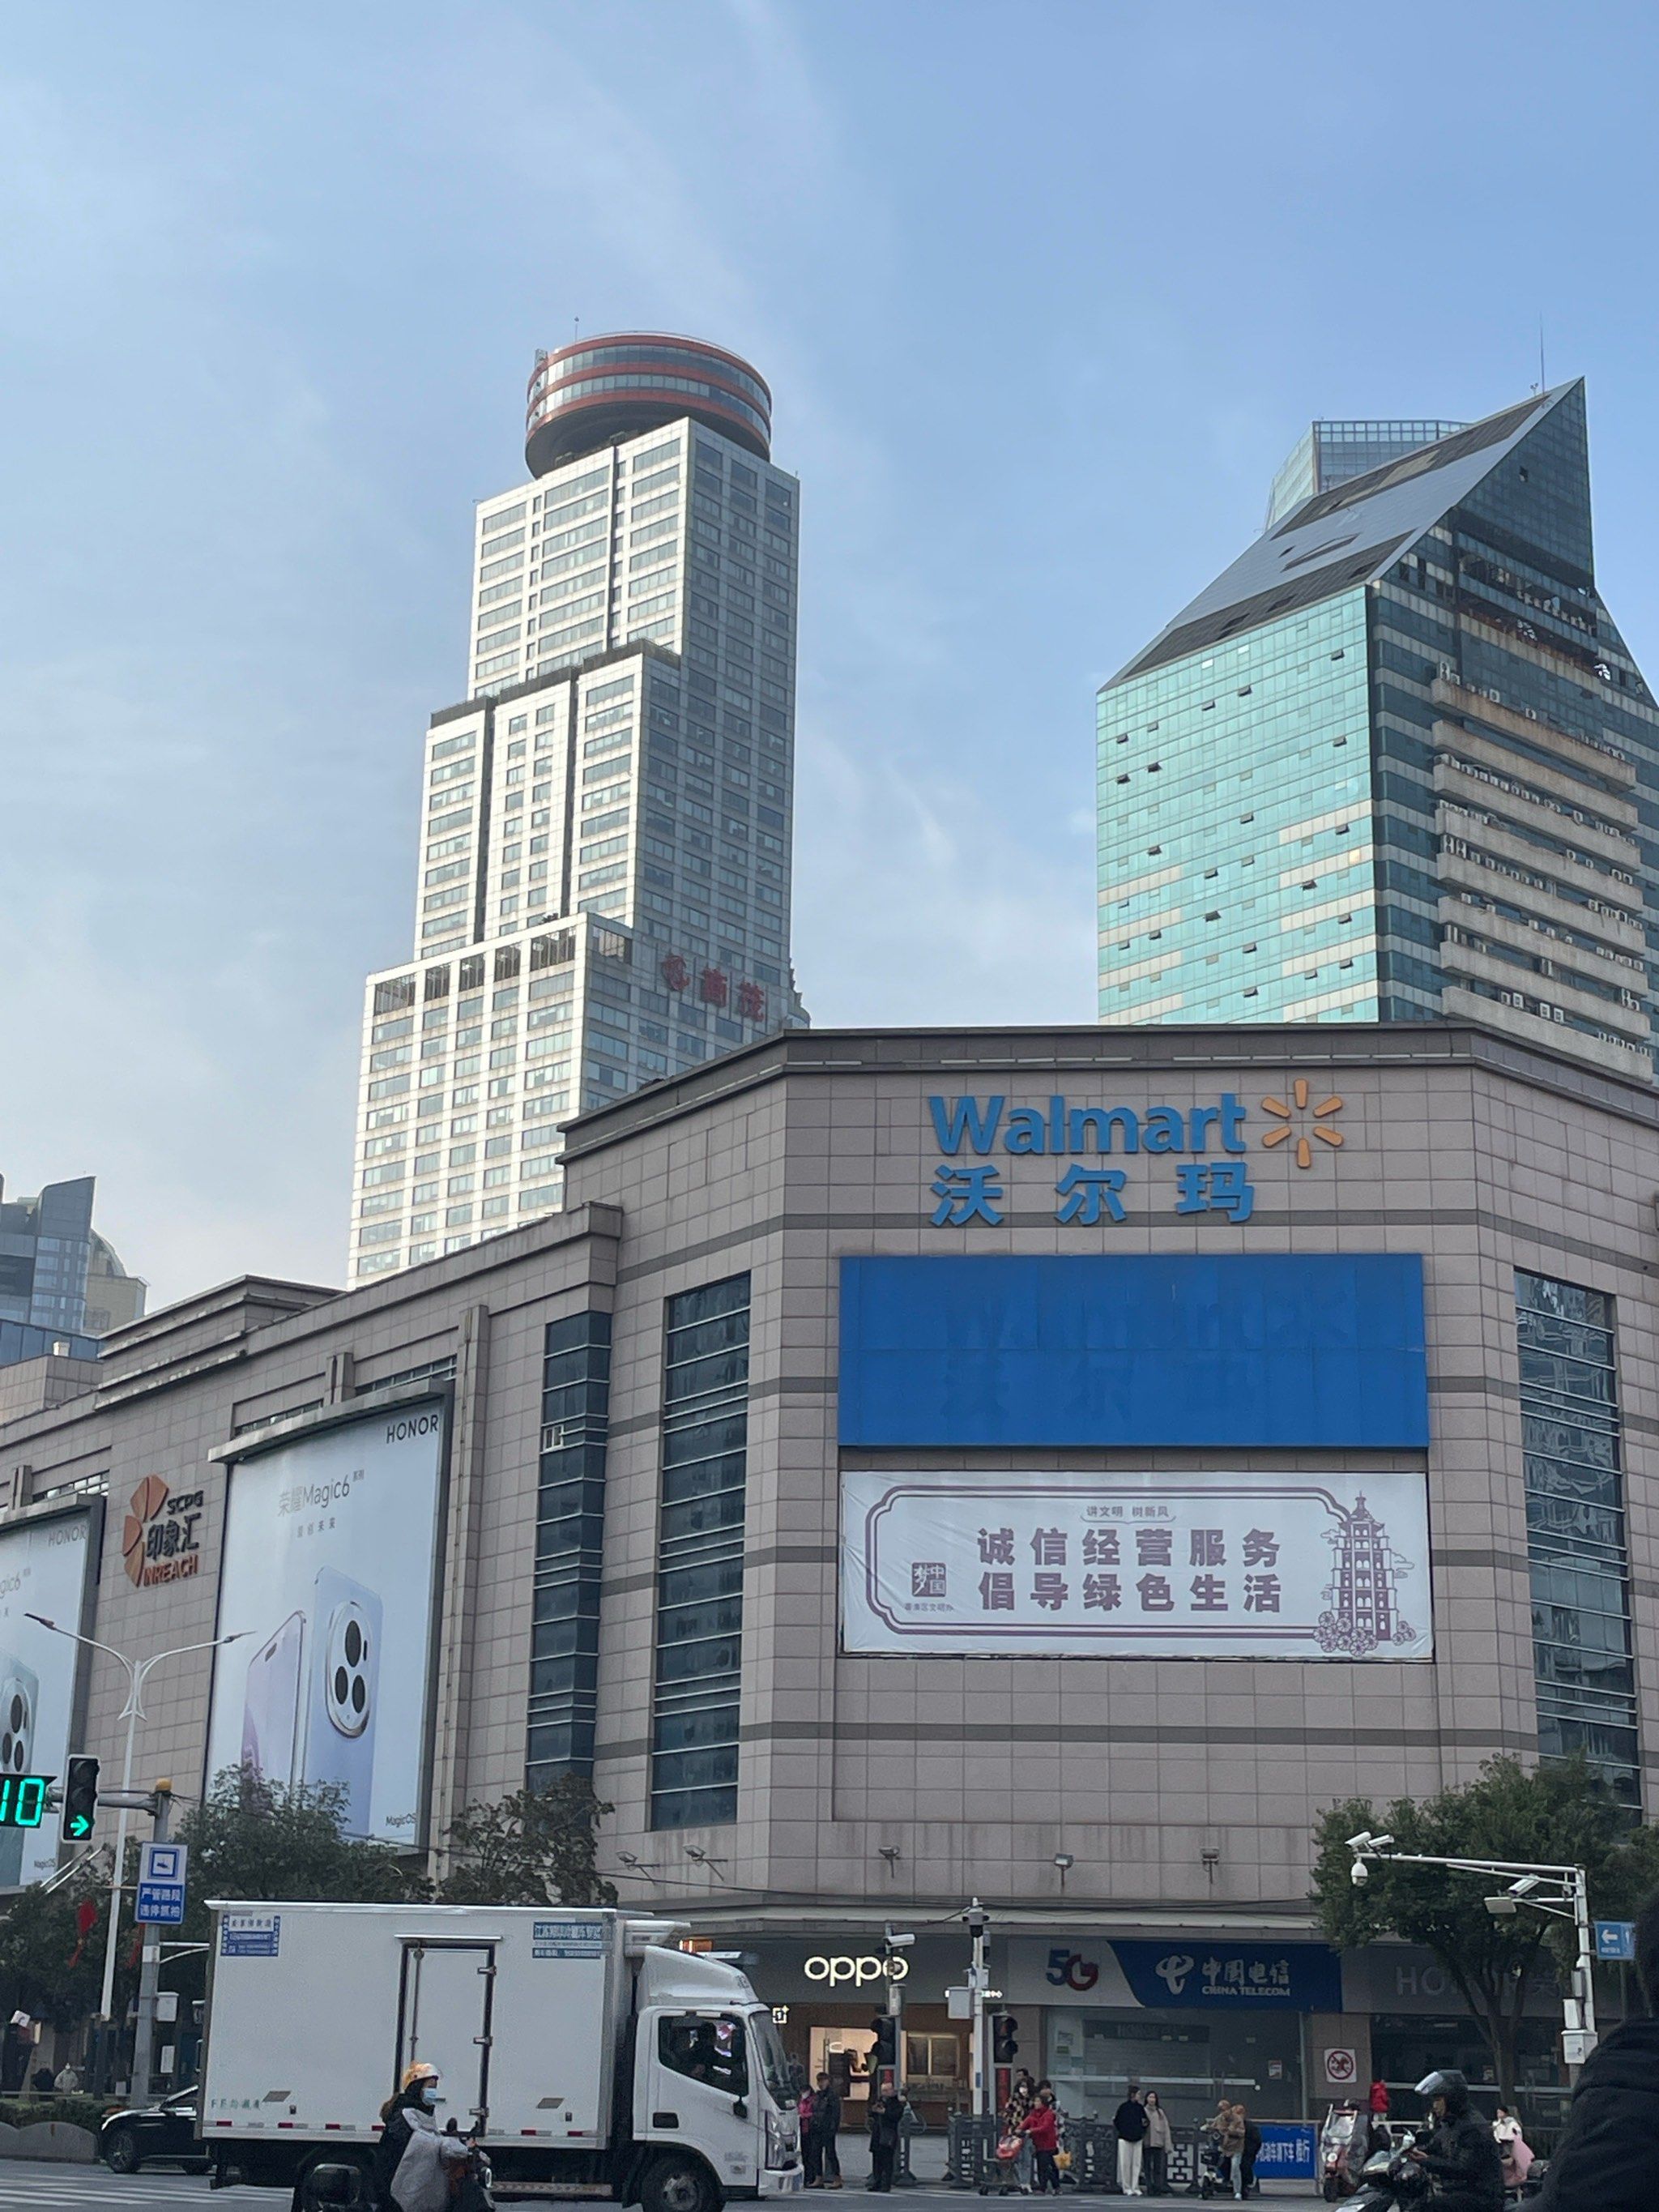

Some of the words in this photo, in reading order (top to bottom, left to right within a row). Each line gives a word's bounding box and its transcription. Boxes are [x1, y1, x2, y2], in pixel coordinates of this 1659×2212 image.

[928, 1092, 1246, 1155] Walmart
[930, 1161, 1254, 1226] 沃尔玛
[386, 1414, 438, 1444] HONOR
[167, 1489, 204, 1515] SCPG
[1086, 1505, 1123, 1517] 讲文明
[1132, 1505, 1169, 1518] 树新风
[48, 1525, 87, 1547] HONOR
[146, 1512, 202, 1561] 印象汇
[977, 1527, 1281, 1567] 诚信经营服务
[978, 1572, 1282, 1612] 倡导绿色生活
[0, 1778, 45, 1826] 10
[141, 1886, 181, 1902] 严管路段
[1046, 1949, 1099, 1992] 5G
[1201, 1957, 1290, 1985] 中国电信
[1201, 1985, 1238, 1996] CHINA
[1239, 1986, 1290, 1996] TELECOM
